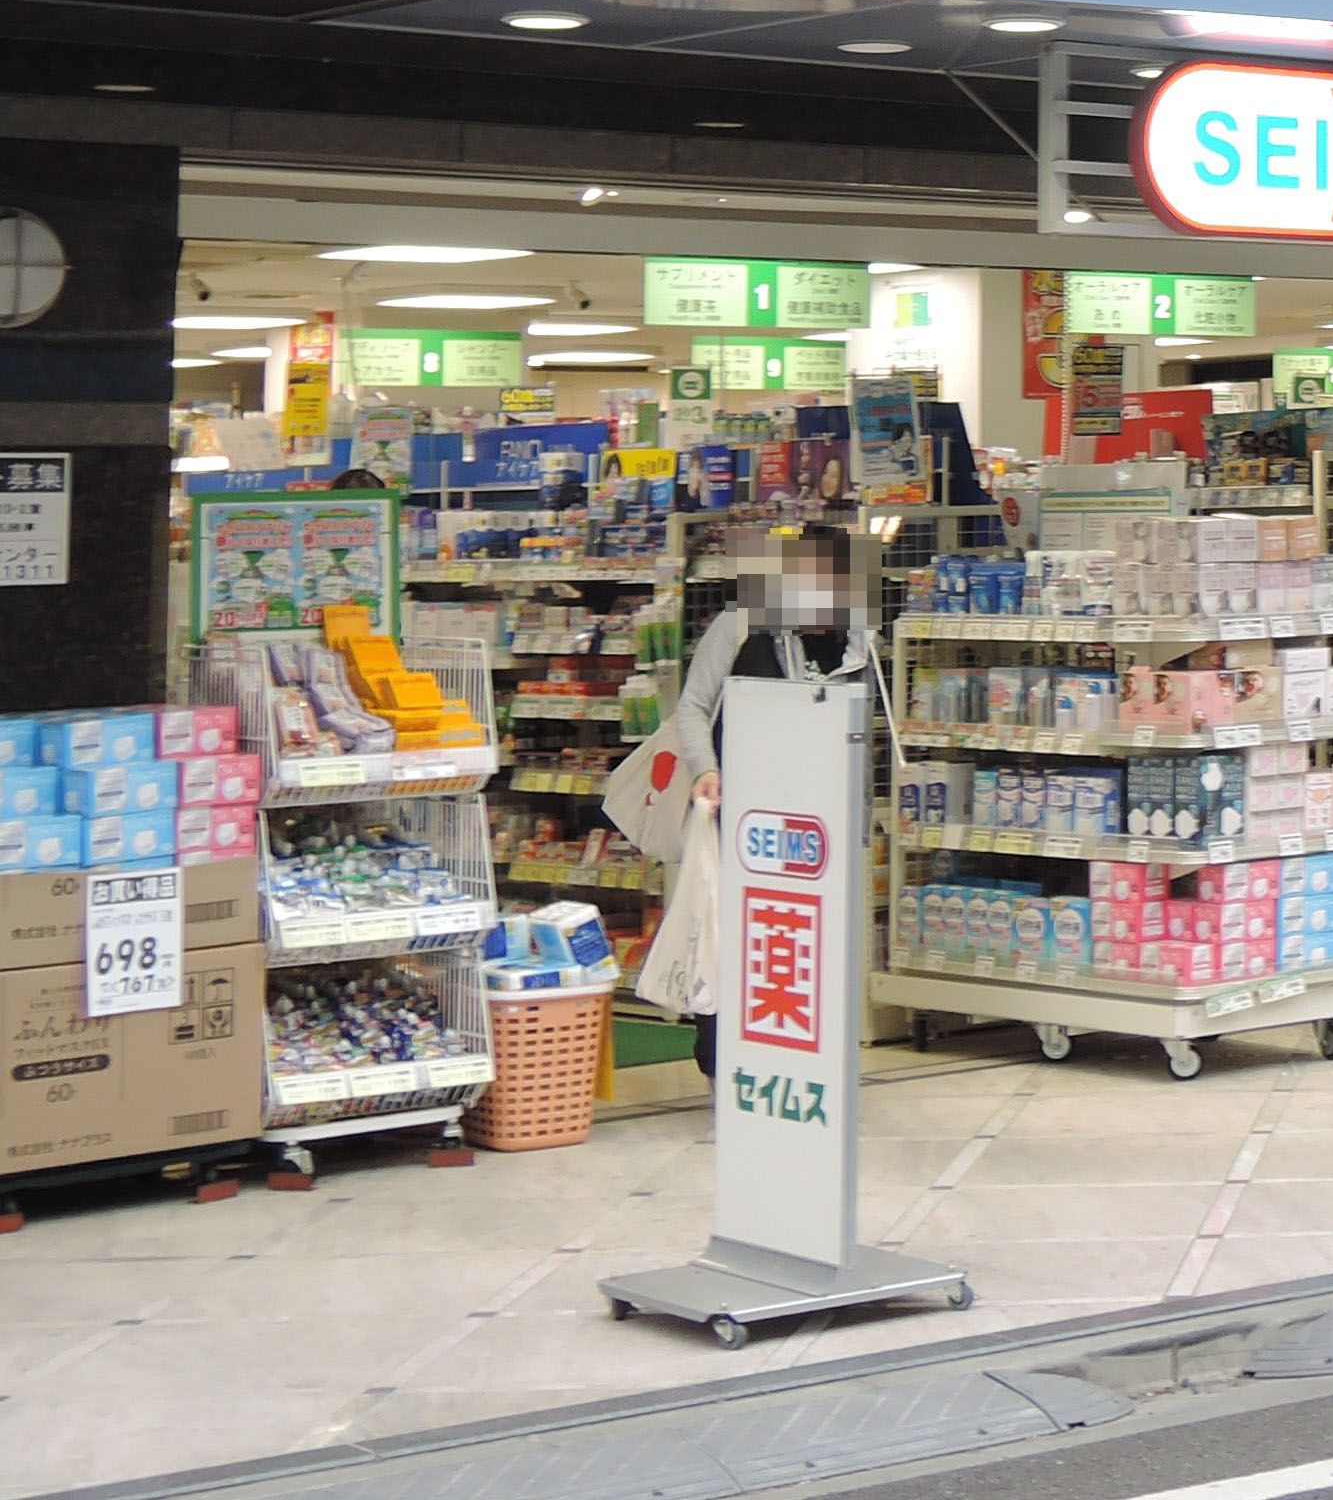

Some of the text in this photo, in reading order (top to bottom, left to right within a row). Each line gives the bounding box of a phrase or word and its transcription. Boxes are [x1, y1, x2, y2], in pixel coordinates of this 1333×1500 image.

[793, 271, 858, 287] ダイエット
[753, 283, 771, 311] 1
[1153, 294, 1171, 319] 2
[422, 351, 441, 373] 8
[765, 358, 783, 378] 9
[0, 462, 64, 491] 募集
[745, 825, 821, 865] SEIMS
[95, 936, 158, 975] 698
[748, 904, 815, 1034] 薬
[732, 1066, 830, 1128] セイムス
